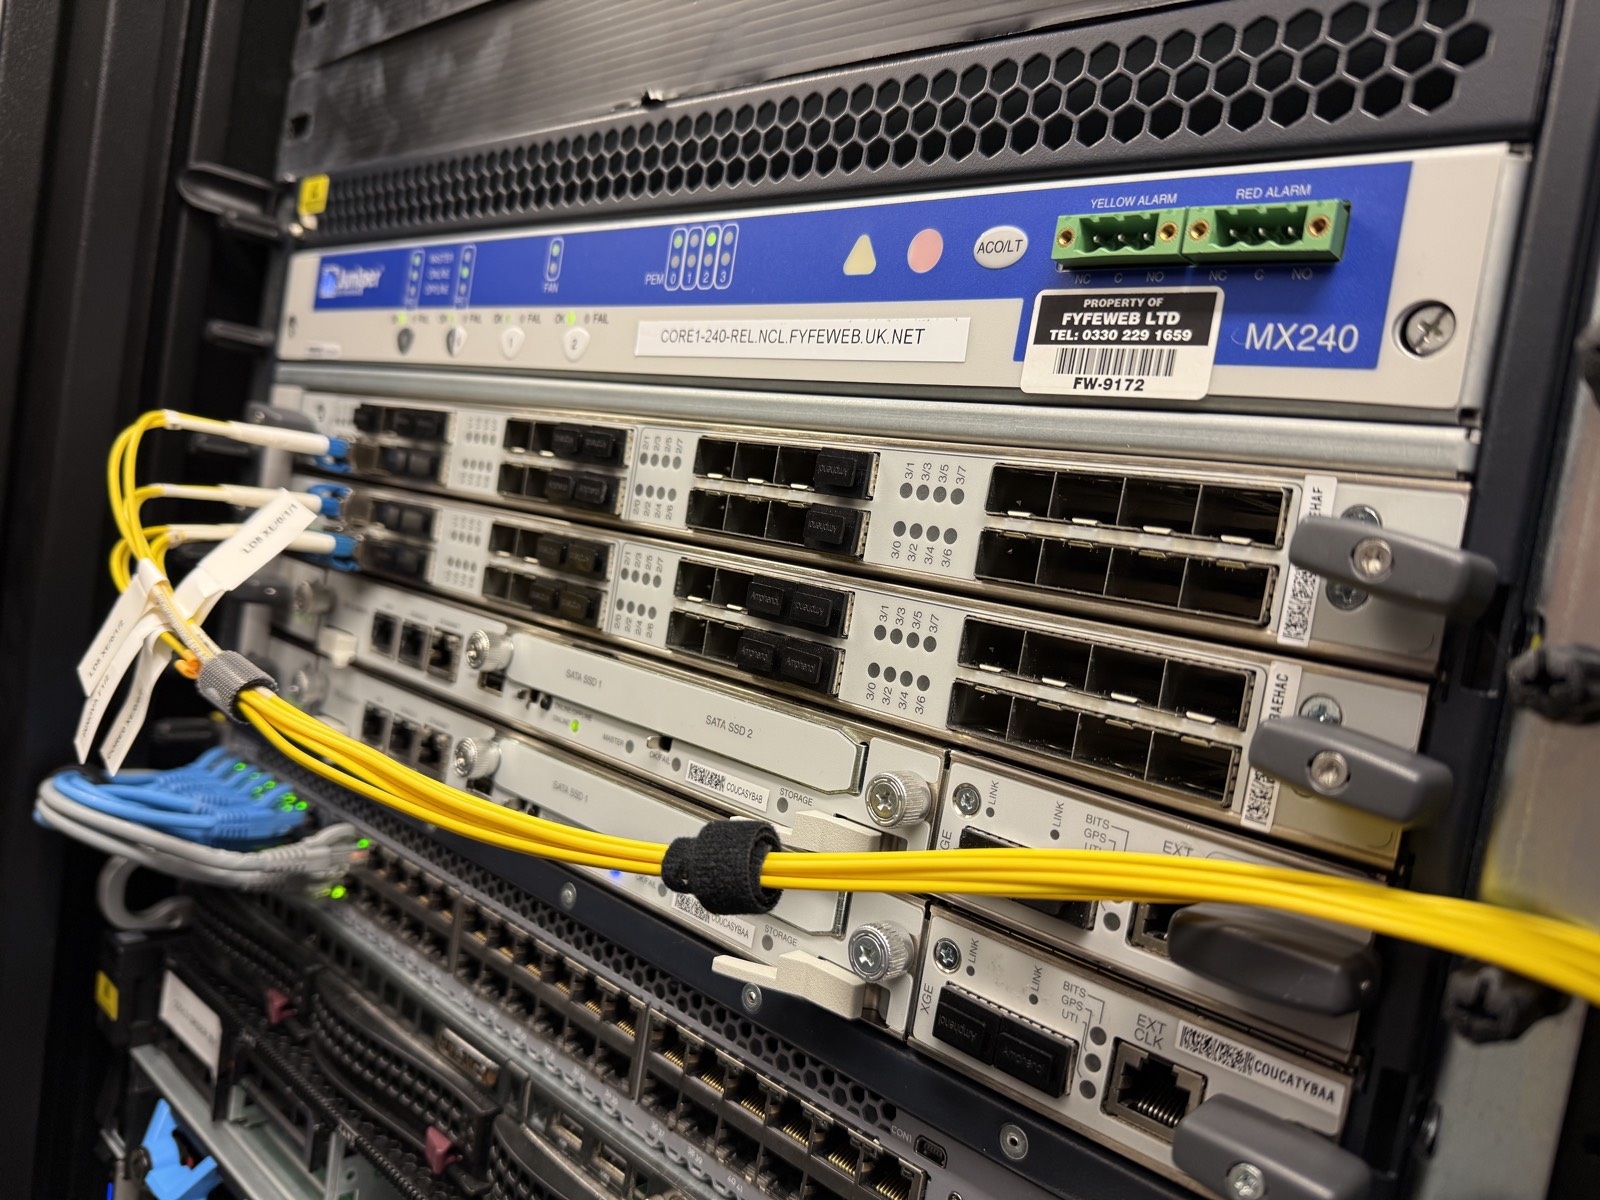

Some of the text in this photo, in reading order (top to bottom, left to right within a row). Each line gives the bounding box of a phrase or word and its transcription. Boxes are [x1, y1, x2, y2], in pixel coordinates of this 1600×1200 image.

[1091, 194, 1177, 208] YELLOW ALARM
[1236, 184, 1312, 200] RED ALARM
[977, 239, 1024, 254] ACO/LT
[645, 272, 664, 286] PEM
[702, 272, 710, 283] 2
[719, 271, 727, 283] 3
[1075, 274, 1091, 285] NC
[1146, 271, 1164, 282] NO
[1209, 270, 1228, 281] NC
[1291, 268, 1313, 280] NO
[1083, 297, 1164, 308] PROPERTY OF
[593, 313, 609, 324] FAIL
[1061, 311, 1181, 326] FYFEWEB LTD
[660, 328, 926, 345] CORE1-240-REL.NCL.FYFEWEB.UK.NET
[1049, 329, 1193, 341] TEL: 0330 229 1659
[1244, 323, 1359, 353] MX240
[1072, 377, 1145, 392] FW-9172
[905, 462, 915, 479] 3/1
[921, 462, 932, 481] 3/3
[938, 464, 949, 483] 3/5
[956, 465, 966, 485] 3/7
[1309, 486, 1323, 517] EHAF
[891, 541, 901, 559] 3/0
[907, 543, 918, 562] 3/2
[924, 546, 934, 565] 3/4
[941, 549, 952, 568] 3/6
[879, 605, 889, 622] 3/1
[895, 607, 906, 626] 3/3
[912, 610, 923, 630] 3/5
[929, 614, 939, 633] 3/7
[565, 669, 582, 681] SATA
[583, 674, 597, 687] SSD
[866, 682, 876, 701] 3/0
[882, 686, 892, 705] 3/2
[898, 691, 908, 710] 3/4
[1269, 673, 1289, 721] BAEHAC
[915, 695, 926, 715] 3/6
[705, 714, 754, 739] SATA SSD 2
[726, 781, 764, 804] COUCASYBAB
[779, 787, 814, 806] STORAGE
[988, 780, 1000, 805] LINK
[1052, 801, 1065, 827] LINK
[1085, 813, 1110, 830] BITS
[940, 829, 952, 850] GE
[1083, 827, 1107, 843] GPS
[764, 924, 798, 947] STORAGE
[967, 938, 979, 963] LINK
[1031, 965, 1043, 992] LINK
[1062, 980, 1087, 998] BITS
[920, 983, 934, 1015] XGE
[1061, 995, 1084, 1011] GPS
[1061, 1009, 1079, 1024] UTI
[1136, 1013, 1167, 1035] EXT
[1134, 1027, 1164, 1050] CLK
[1254, 1059, 1336, 1103] COUCATYBAA
